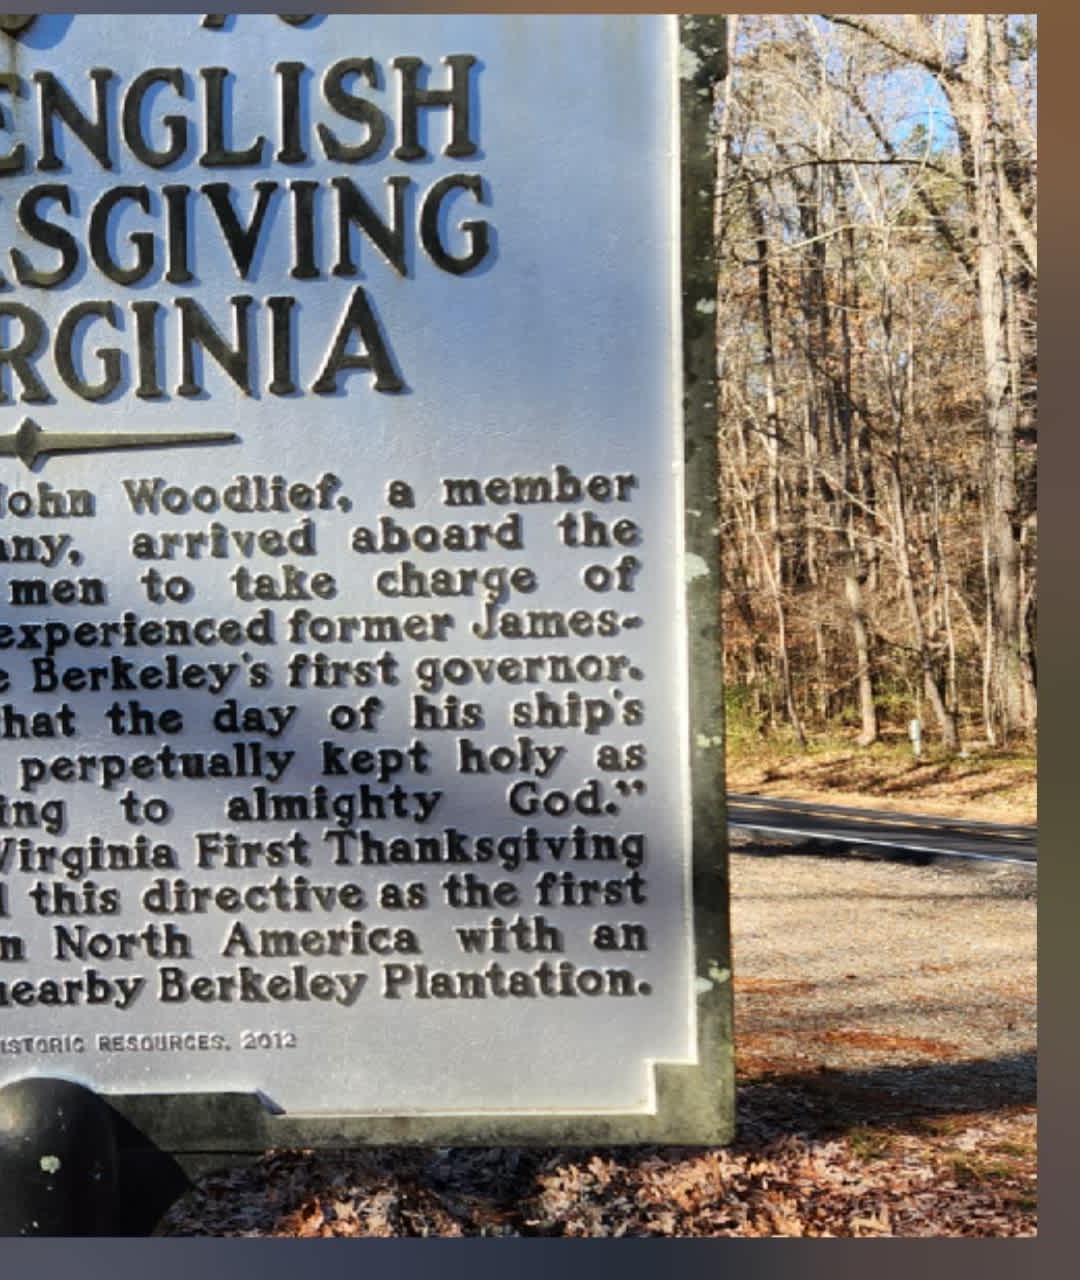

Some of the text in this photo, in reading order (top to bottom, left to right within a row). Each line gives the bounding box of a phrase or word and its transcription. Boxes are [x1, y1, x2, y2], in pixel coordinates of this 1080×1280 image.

[389, 481, 415, 509] a
[444, 465, 639, 506] member
[133, 520, 317, 560] arrived
[352, 514, 524, 554] aboard
[558, 511, 642, 548] the
[10, 579, 104, 607] men
[141, 568, 194, 605] to
[231, 565, 337, 602] take
[377, 561, 538, 604] charge
[584, 556, 642, 593] of
[288, 609, 454, 645] former
[473, 600, 643, 640] James-
[32, 653, 268, 694] Berkeley's
[288, 652, 399, 689] first
[417, 655, 644, 692] governor.
[106, 700, 183, 736] the
[212, 700, 296, 738] day
[331, 697, 382, 733] of
[414, 695, 485, 731] his
[514, 690, 643, 735] ship's
[21, 743, 296, 789] perpetually
[322, 743, 428, 784] kept
[460, 739, 566, 776] holy
[597, 744, 646, 772] as
[121, 791, 172, 825] to
[229, 784, 443, 827] almighty
[509, 780, 644, 817] God.”
[196, 832, 312, 869] First
[324, 827, 644, 871] Thanksgiving
[29, 881, 120, 917] this
[143, 876, 368, 913] directive
[381, 883, 428, 910] as
[443, 873, 520, 908] the
[536, 868, 646, 907] first
[54, 924, 192, 961] North
[222, 920, 420, 958] America
[456, 916, 564, 953] with
[594, 924, 648, 951] an
[160, 965, 368, 1006] Berkeley
[384, 962, 652, 999] Plantation.
[244, 1033, 298, 1050] 2012
